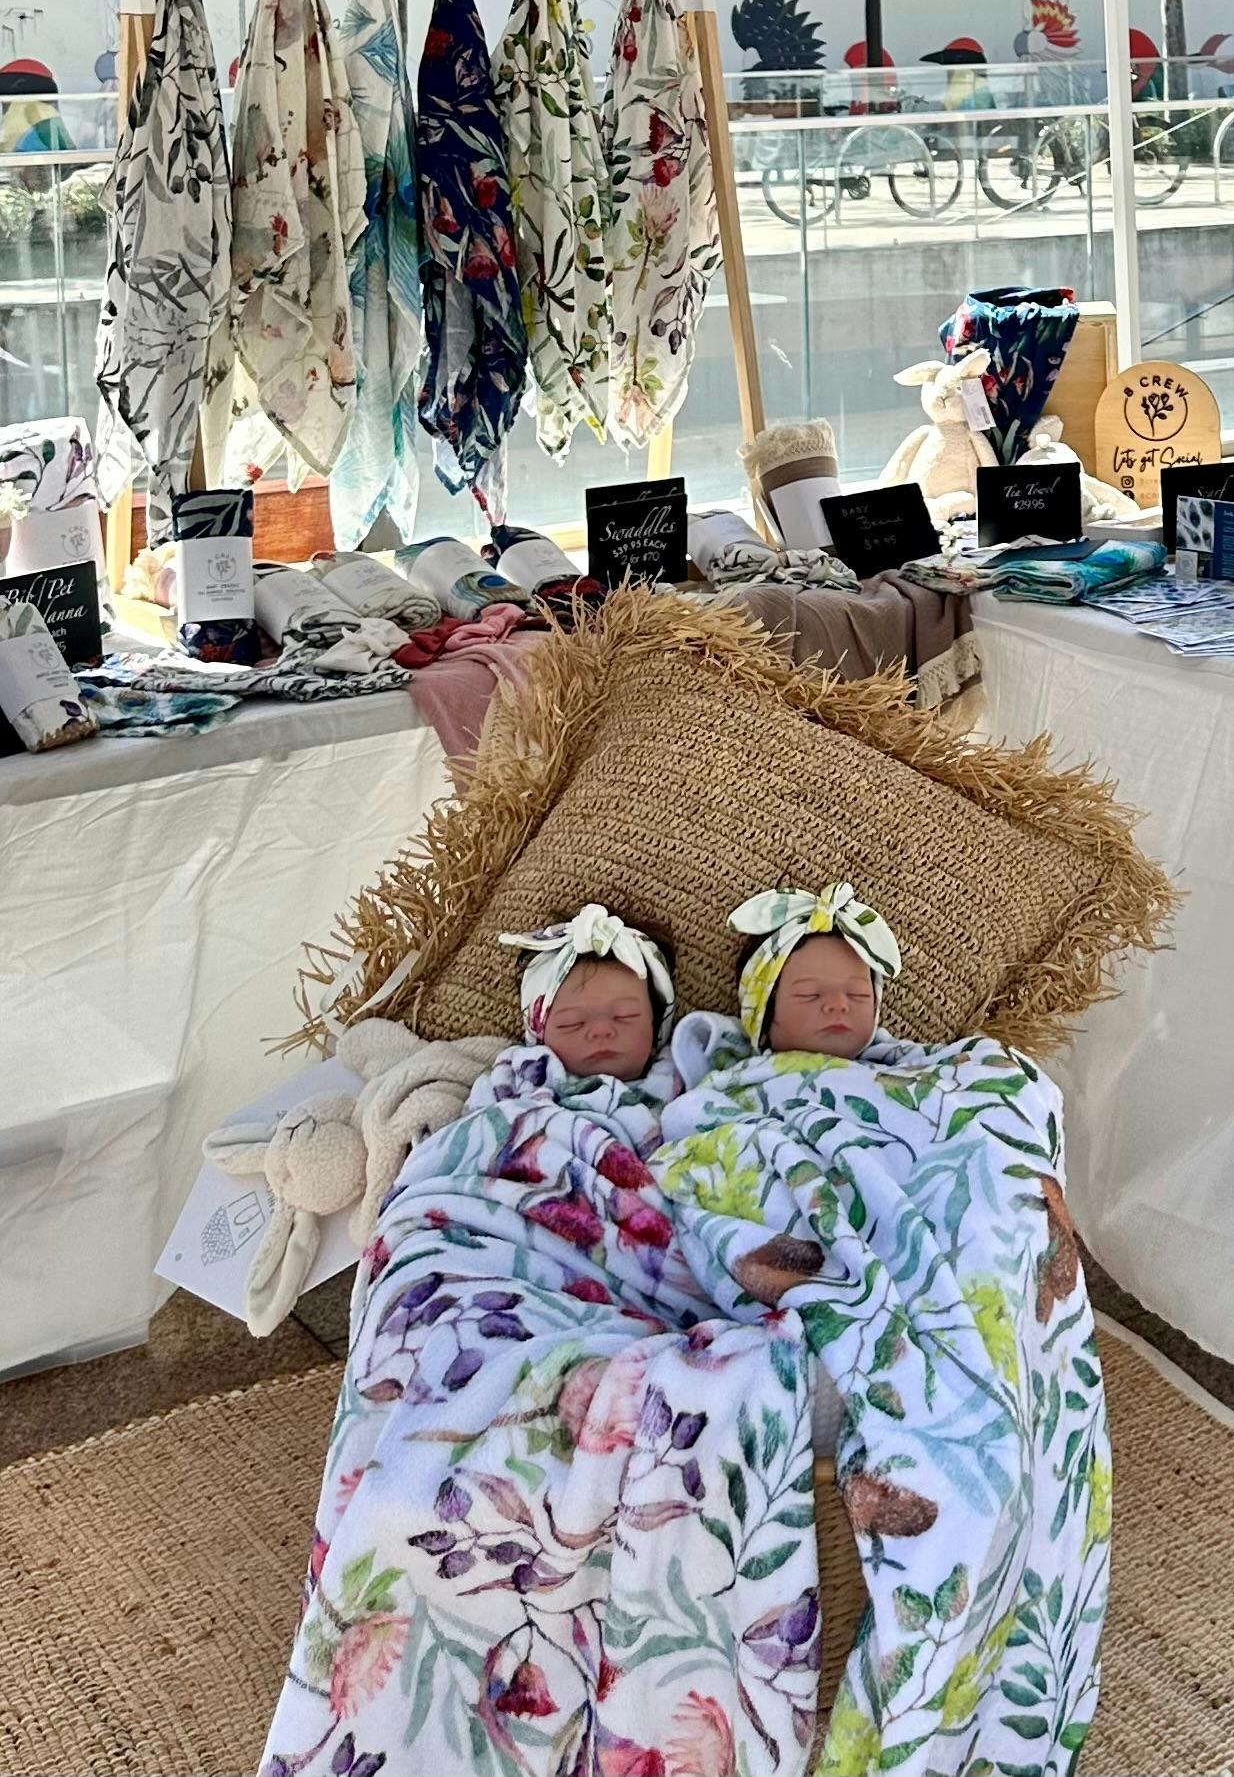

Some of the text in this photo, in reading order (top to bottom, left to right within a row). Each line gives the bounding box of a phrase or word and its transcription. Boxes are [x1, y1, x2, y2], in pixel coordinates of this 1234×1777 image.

[1139, 375, 1189, 398] CREW
[1140, 448, 1160, 473] get
[1160, 446, 1203, 468] Social
[599, 505, 677, 541] Swaddles
[643, 538, 667, 551] EACH
